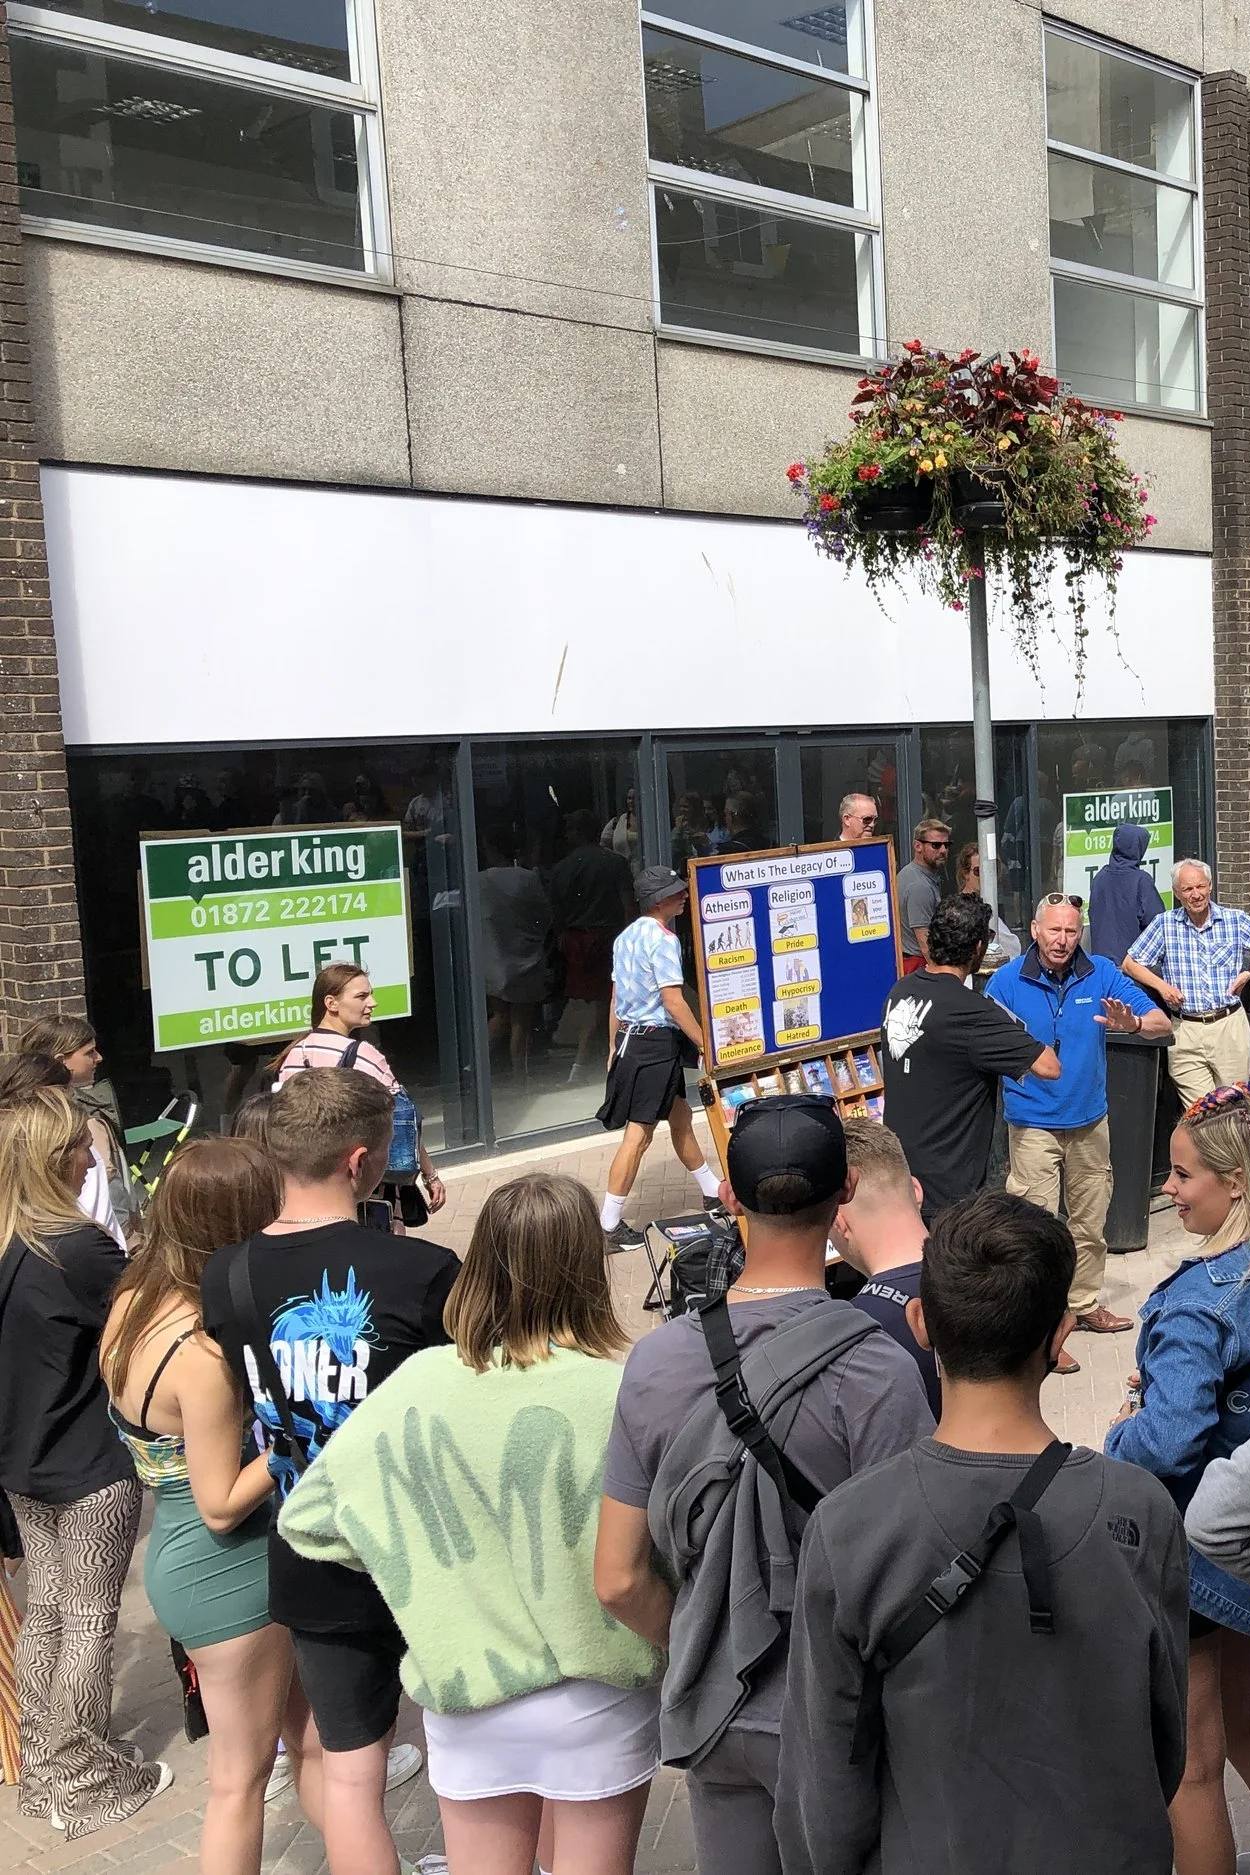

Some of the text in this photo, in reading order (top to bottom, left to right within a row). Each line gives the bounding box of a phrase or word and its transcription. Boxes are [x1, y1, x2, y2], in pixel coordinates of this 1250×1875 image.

[1084, 794, 1160, 822] alder king
[1084, 834, 1114, 850] 0187
[187, 837, 367, 884] alder king
[725, 868, 755, 882] What
[757, 867, 766, 878] Is
[768, 864, 788, 877] The
[790, 861, 823, 875] Legacy
[825, 857, 838, 869] Of
[852, 880, 877, 891] Jesus
[771, 888, 812, 904] Religion
[190, 892, 368, 928] 01872 222174
[704, 899, 750, 915] Atheism
[861, 928, 877, 936] Love
[786, 939, 804, 949] Pride
[718, 953, 745, 966] Racism
[194, 947, 263, 991] TO
[781, 982, 816, 998] Hypocrisy
[725, 1002, 748, 1014] Death
[199, 1001, 313, 1035] alderking
[786, 1028, 810, 1041] Hatred
[860, 1283, 910, 1306] REM
[243, 1338, 371, 1404] LONER
